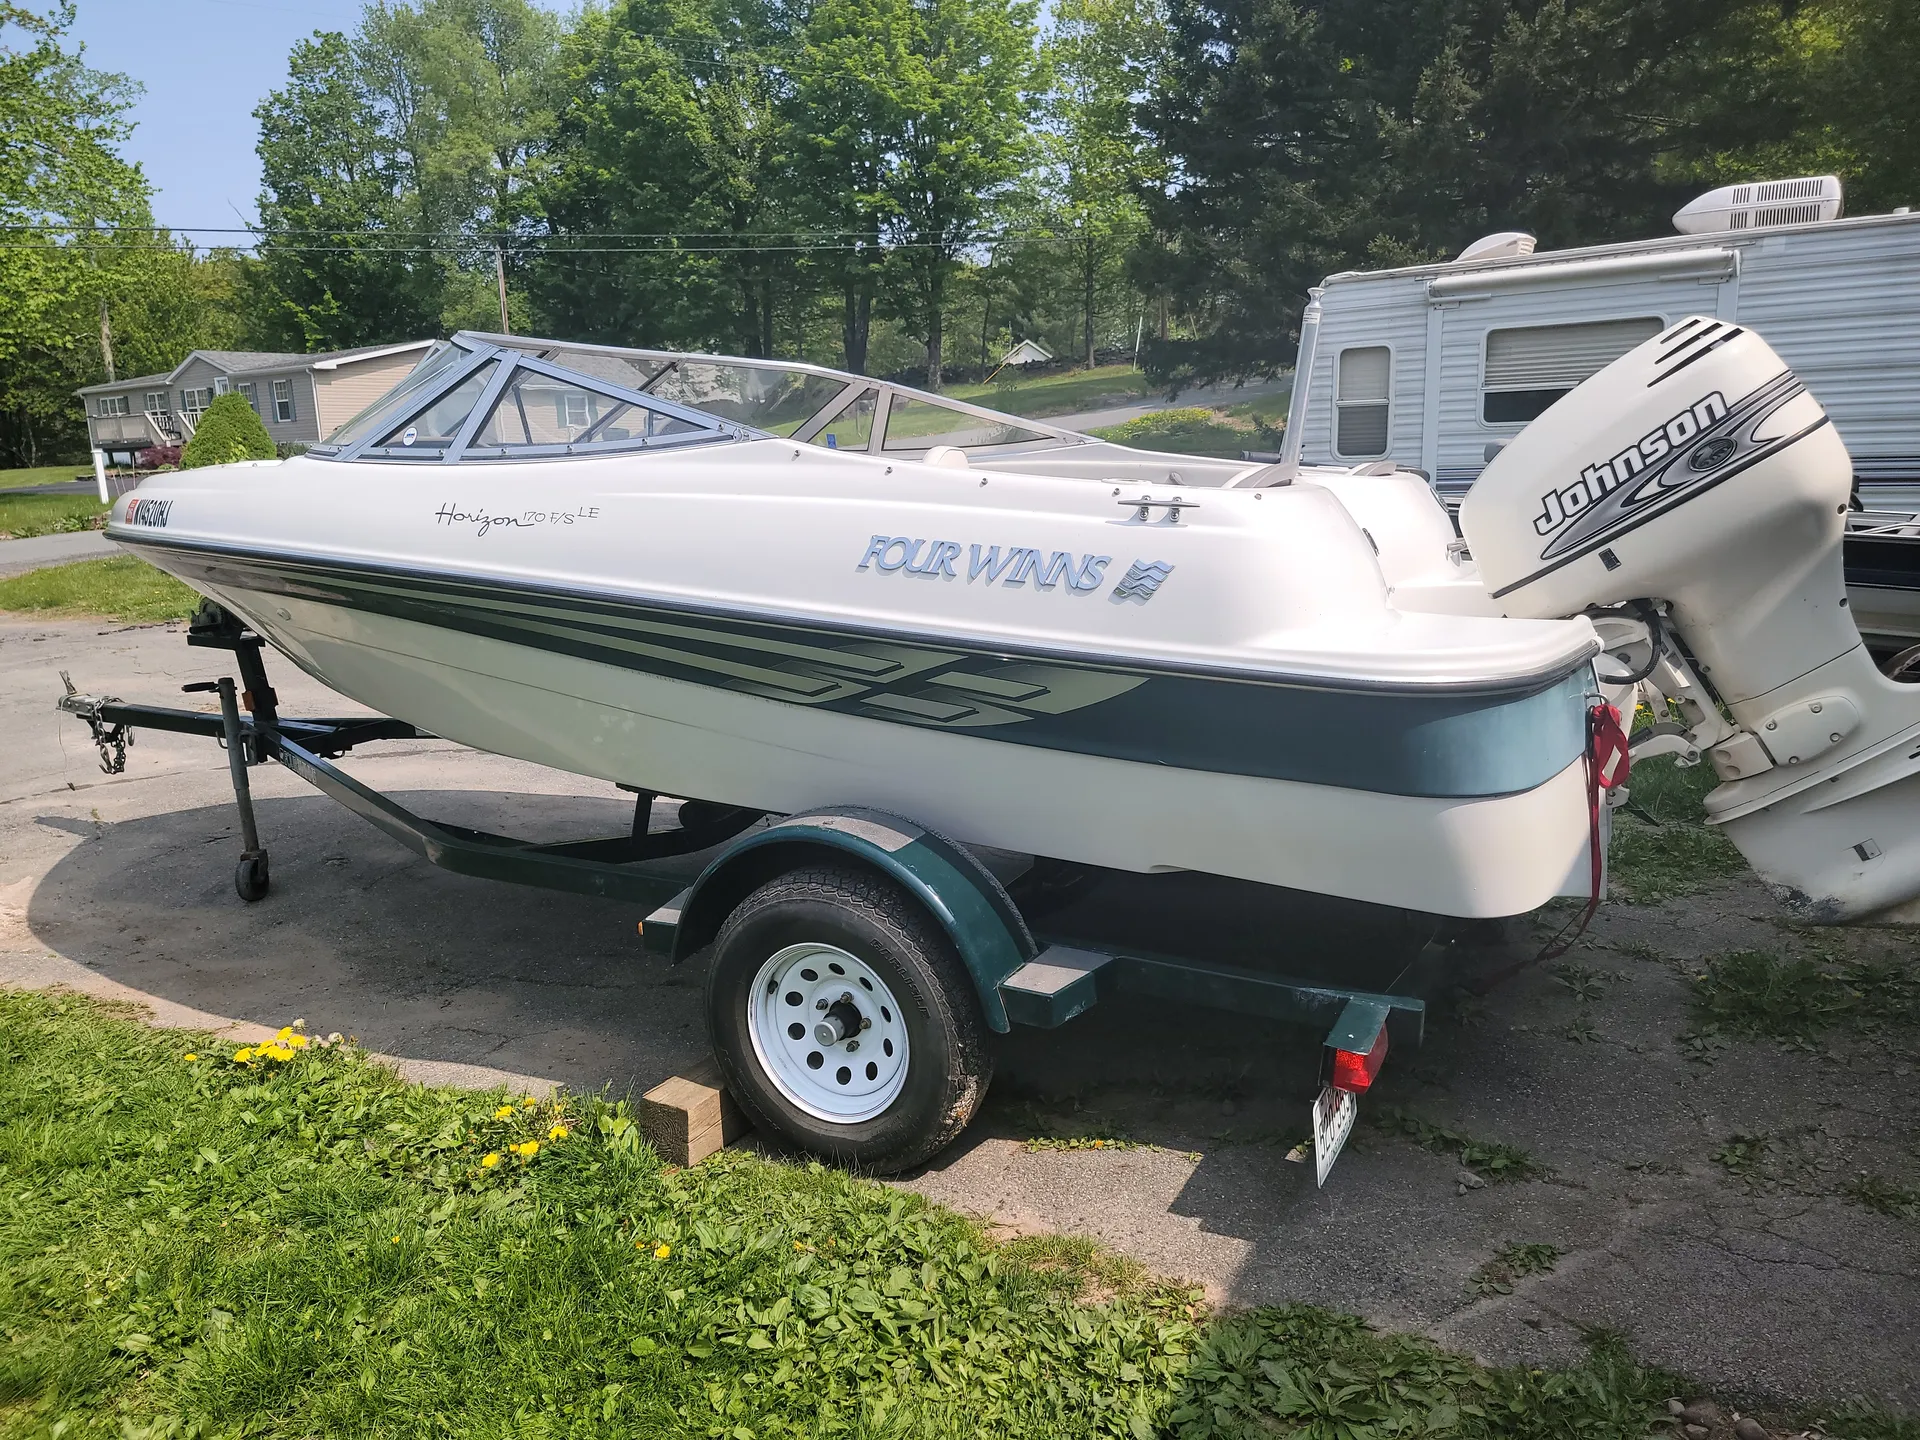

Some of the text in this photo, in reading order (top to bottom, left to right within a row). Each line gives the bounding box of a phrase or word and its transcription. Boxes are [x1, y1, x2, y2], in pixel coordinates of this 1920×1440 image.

[1533, 390, 1729, 536] Johnson
[435, 502, 600, 538] Horizon 170 F/S LE
[858, 534, 1113, 590] FOUR WINNS
